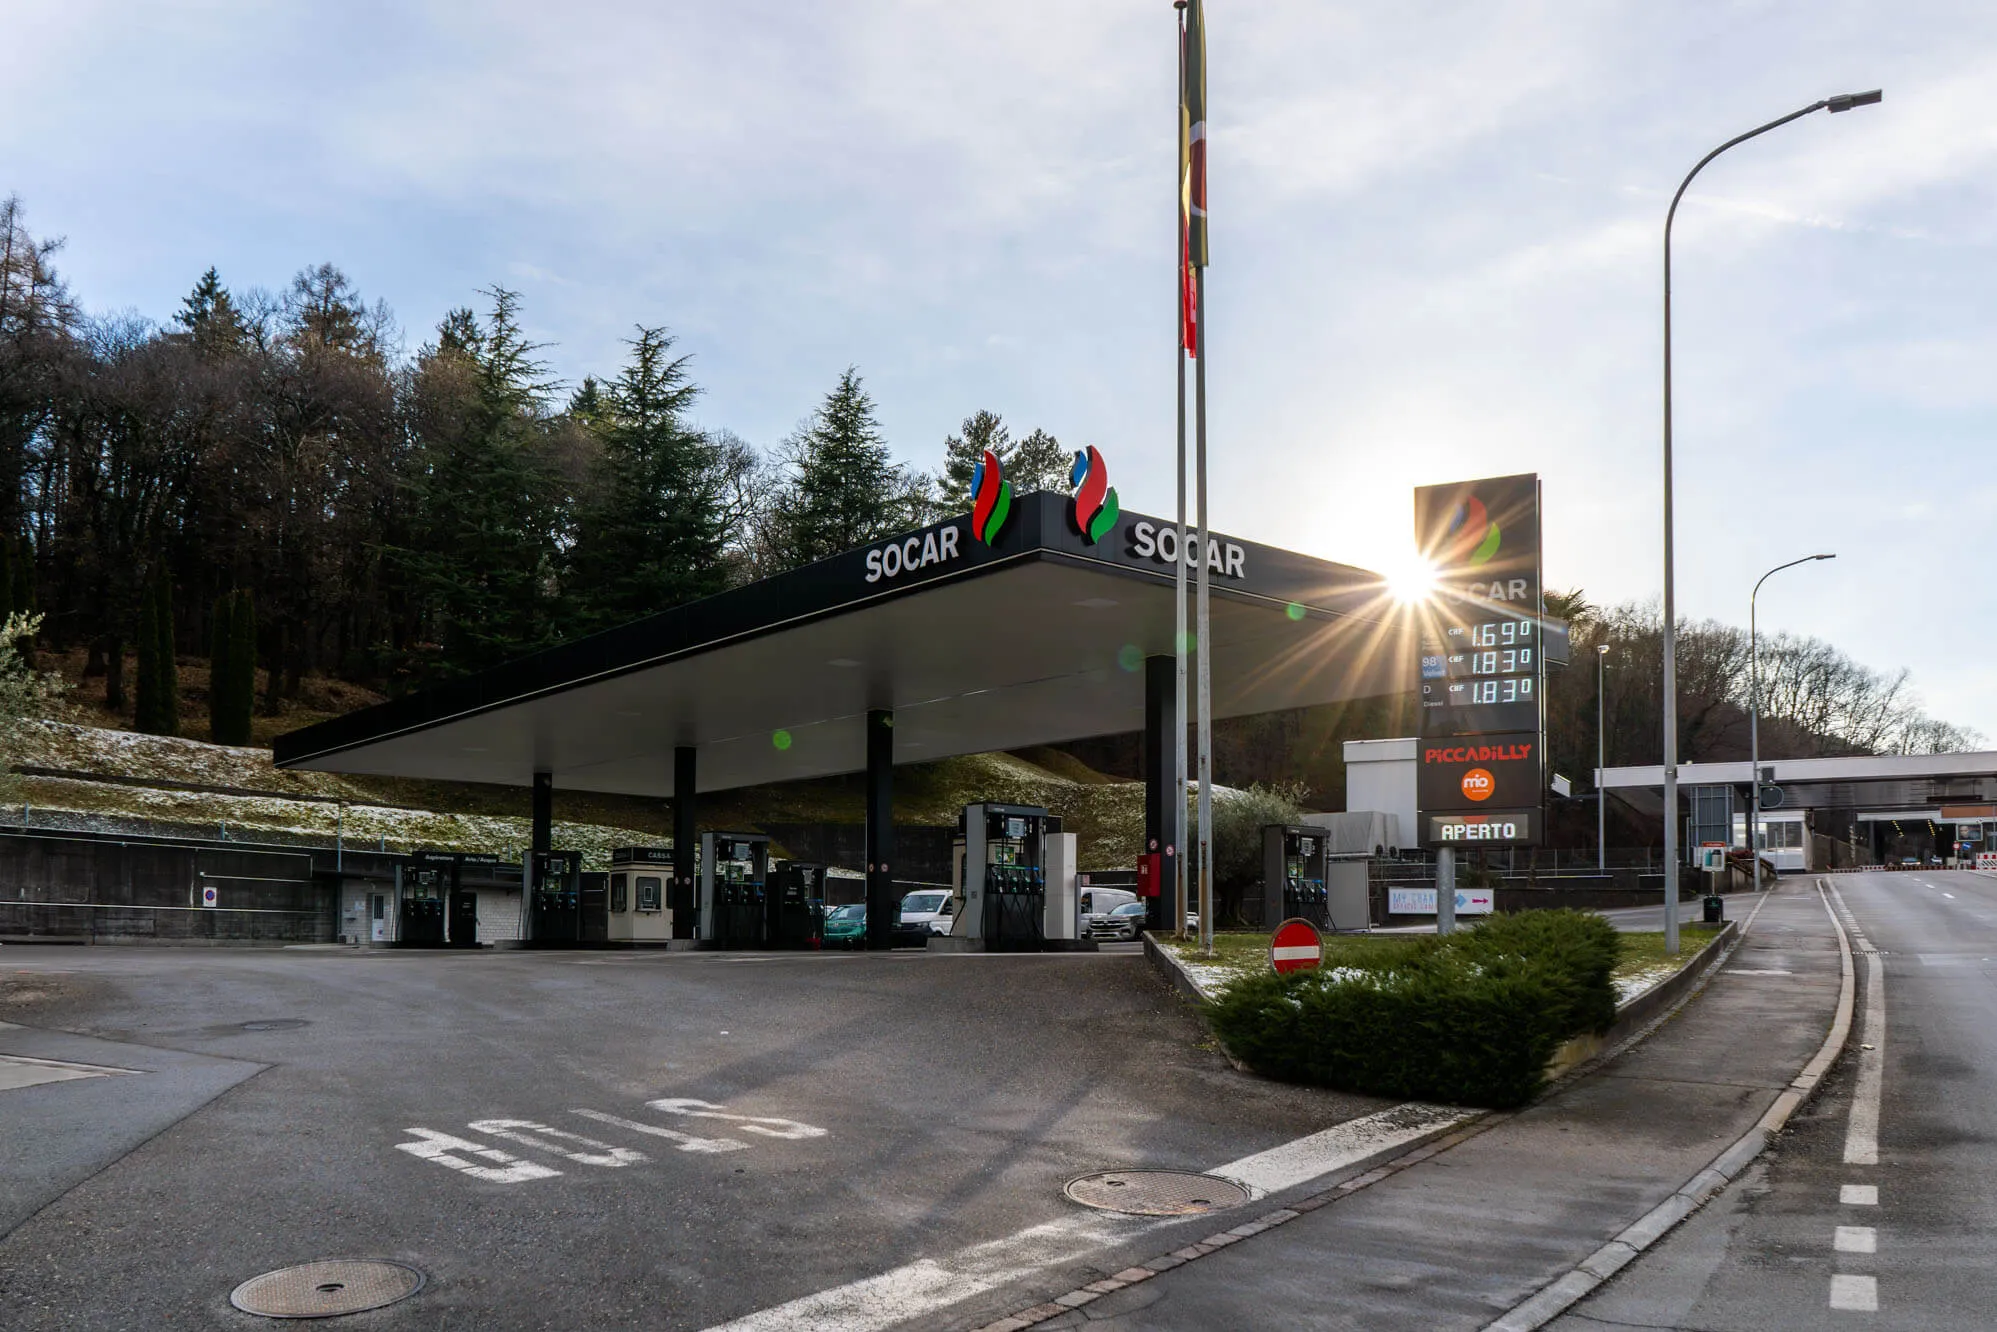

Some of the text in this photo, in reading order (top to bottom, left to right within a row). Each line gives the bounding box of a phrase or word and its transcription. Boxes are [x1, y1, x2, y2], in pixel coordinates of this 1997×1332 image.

[866, 526, 960, 583] SOCAR
[1423, 685, 1431, 694] D
[1441, 822, 1516, 841] APERTO
[393, 1097, 828, 1184] STOP
